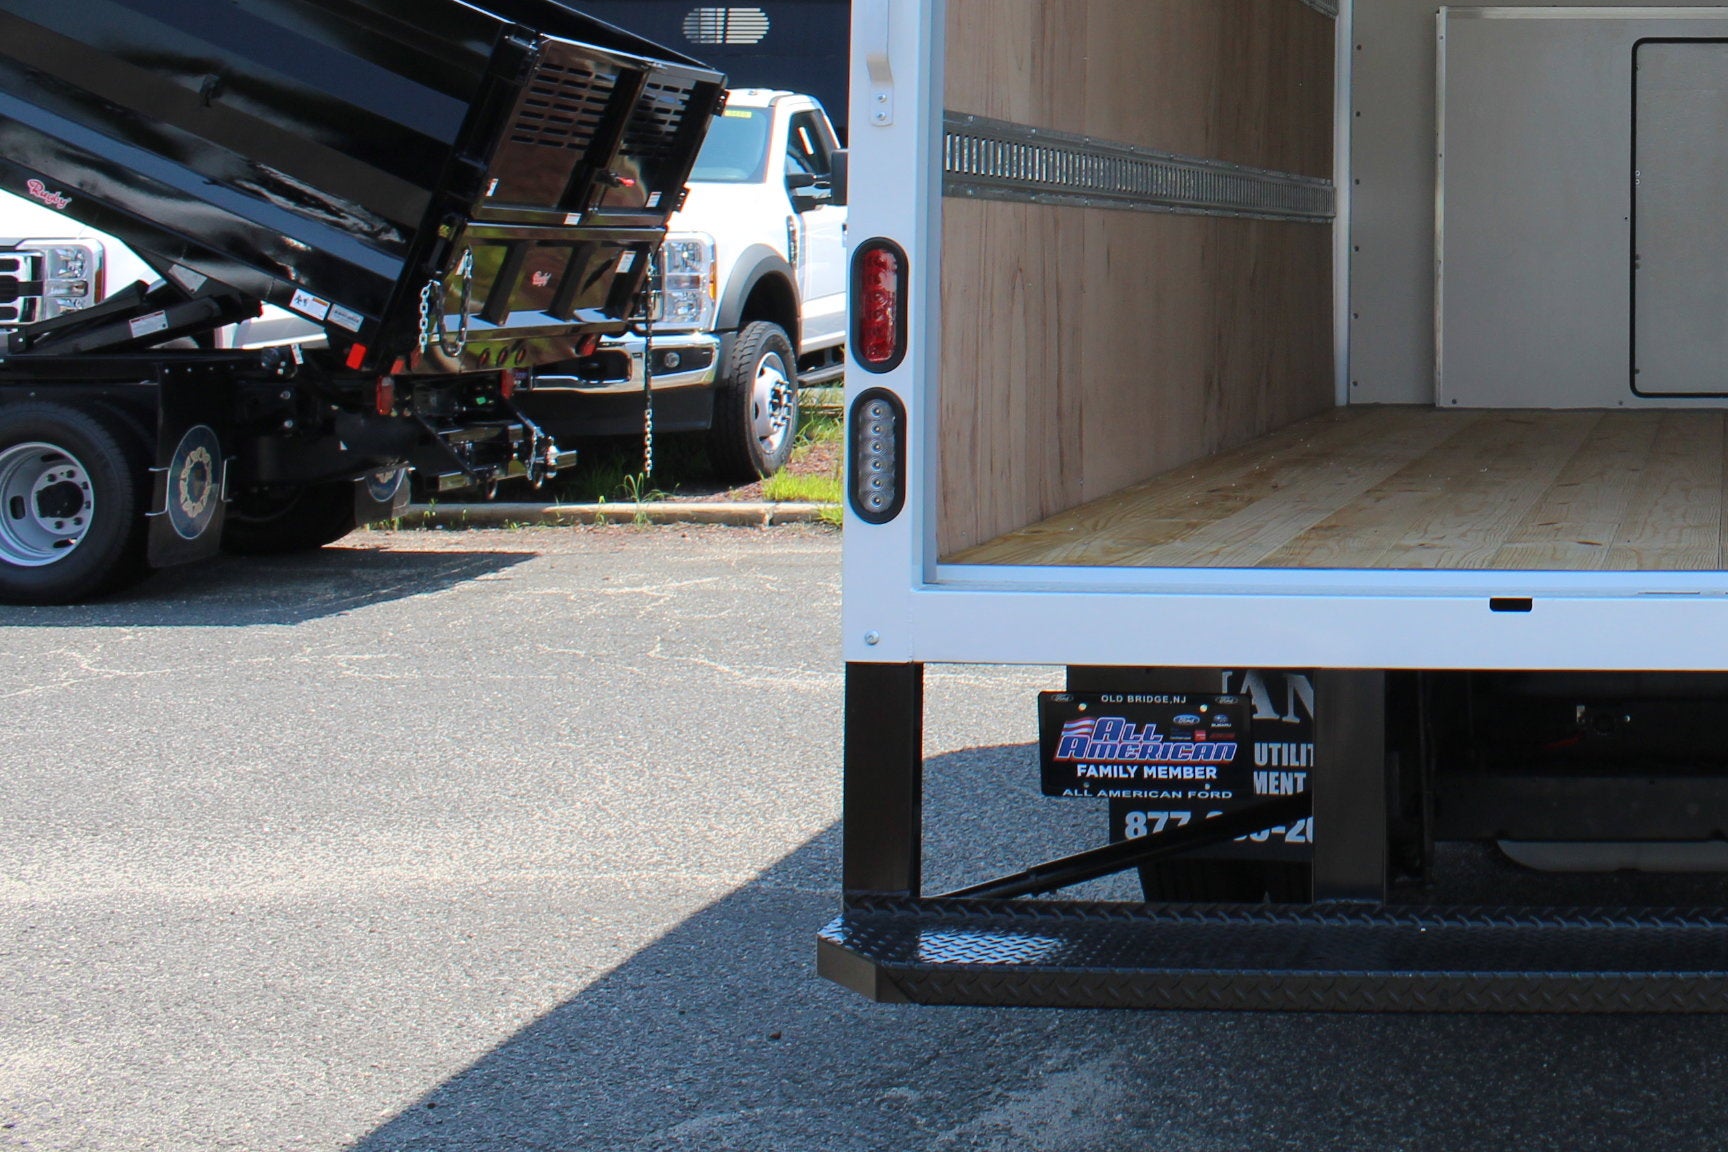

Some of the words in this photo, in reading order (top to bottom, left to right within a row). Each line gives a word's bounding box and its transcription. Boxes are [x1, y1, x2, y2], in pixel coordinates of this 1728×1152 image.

[27, 178, 73, 209] Rugby
[1101, 694, 1124, 704] OLD
[1076, 764, 1138, 779] FAMILY
[1143, 765, 1218, 780] MEMBER
[1062, 788, 1093, 797] ALL
[1097, 789, 1182, 799] AMERICAN
[1187, 790, 1233, 799] FORD
